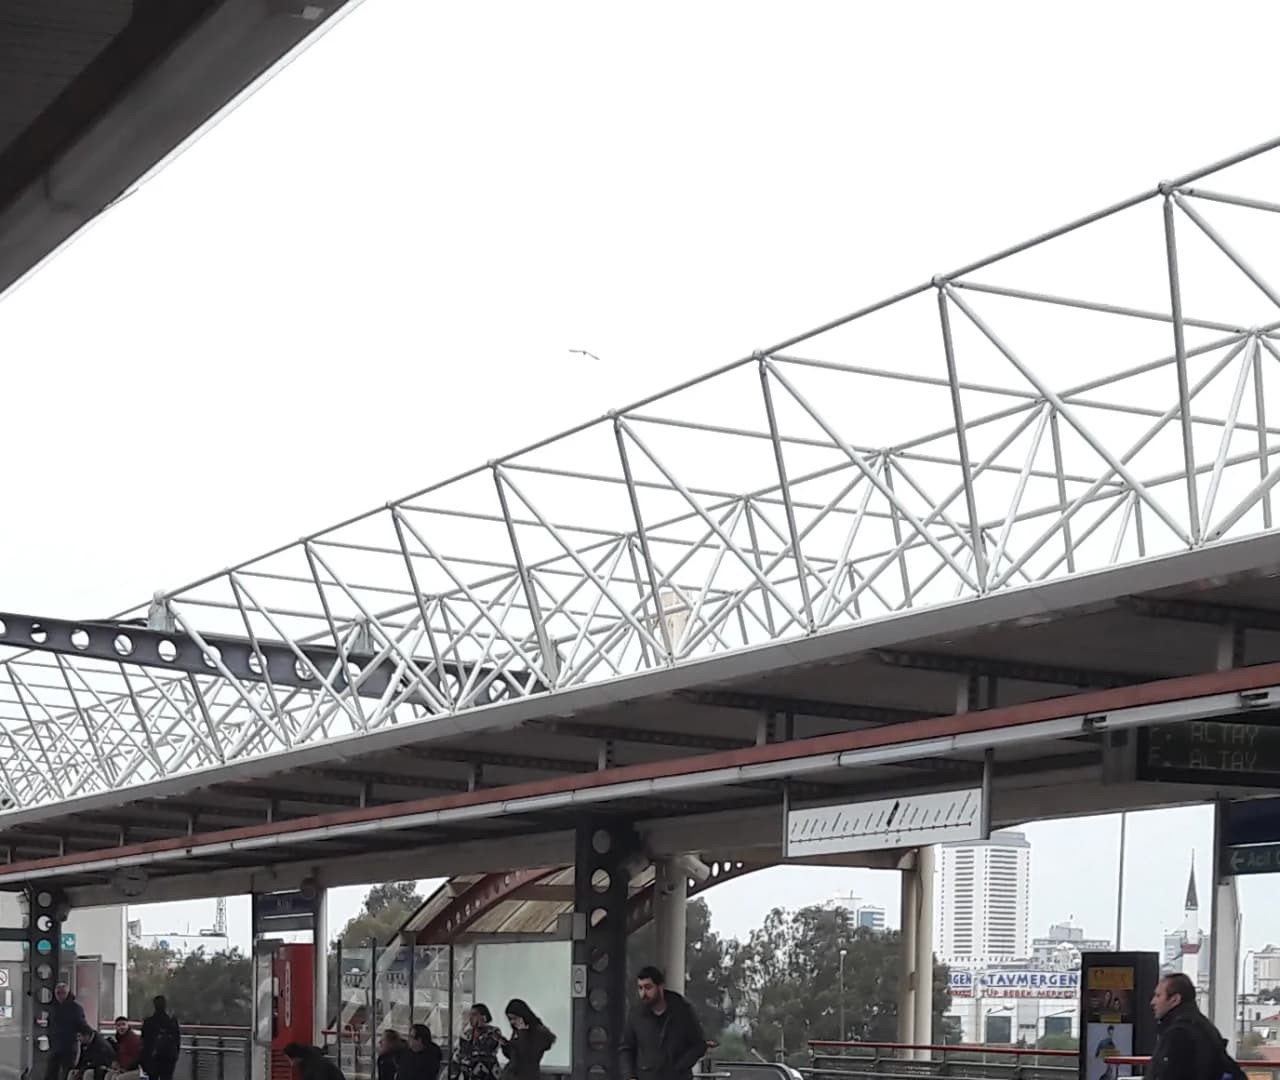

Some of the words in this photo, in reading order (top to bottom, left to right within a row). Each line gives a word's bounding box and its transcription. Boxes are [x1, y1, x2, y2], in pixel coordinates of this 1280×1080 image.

[1191, 722, 1259, 746] ALTAY
[1189, 748, 1257, 772] ALTAY
[987, 973, 1079, 986] TAVMERGEN
